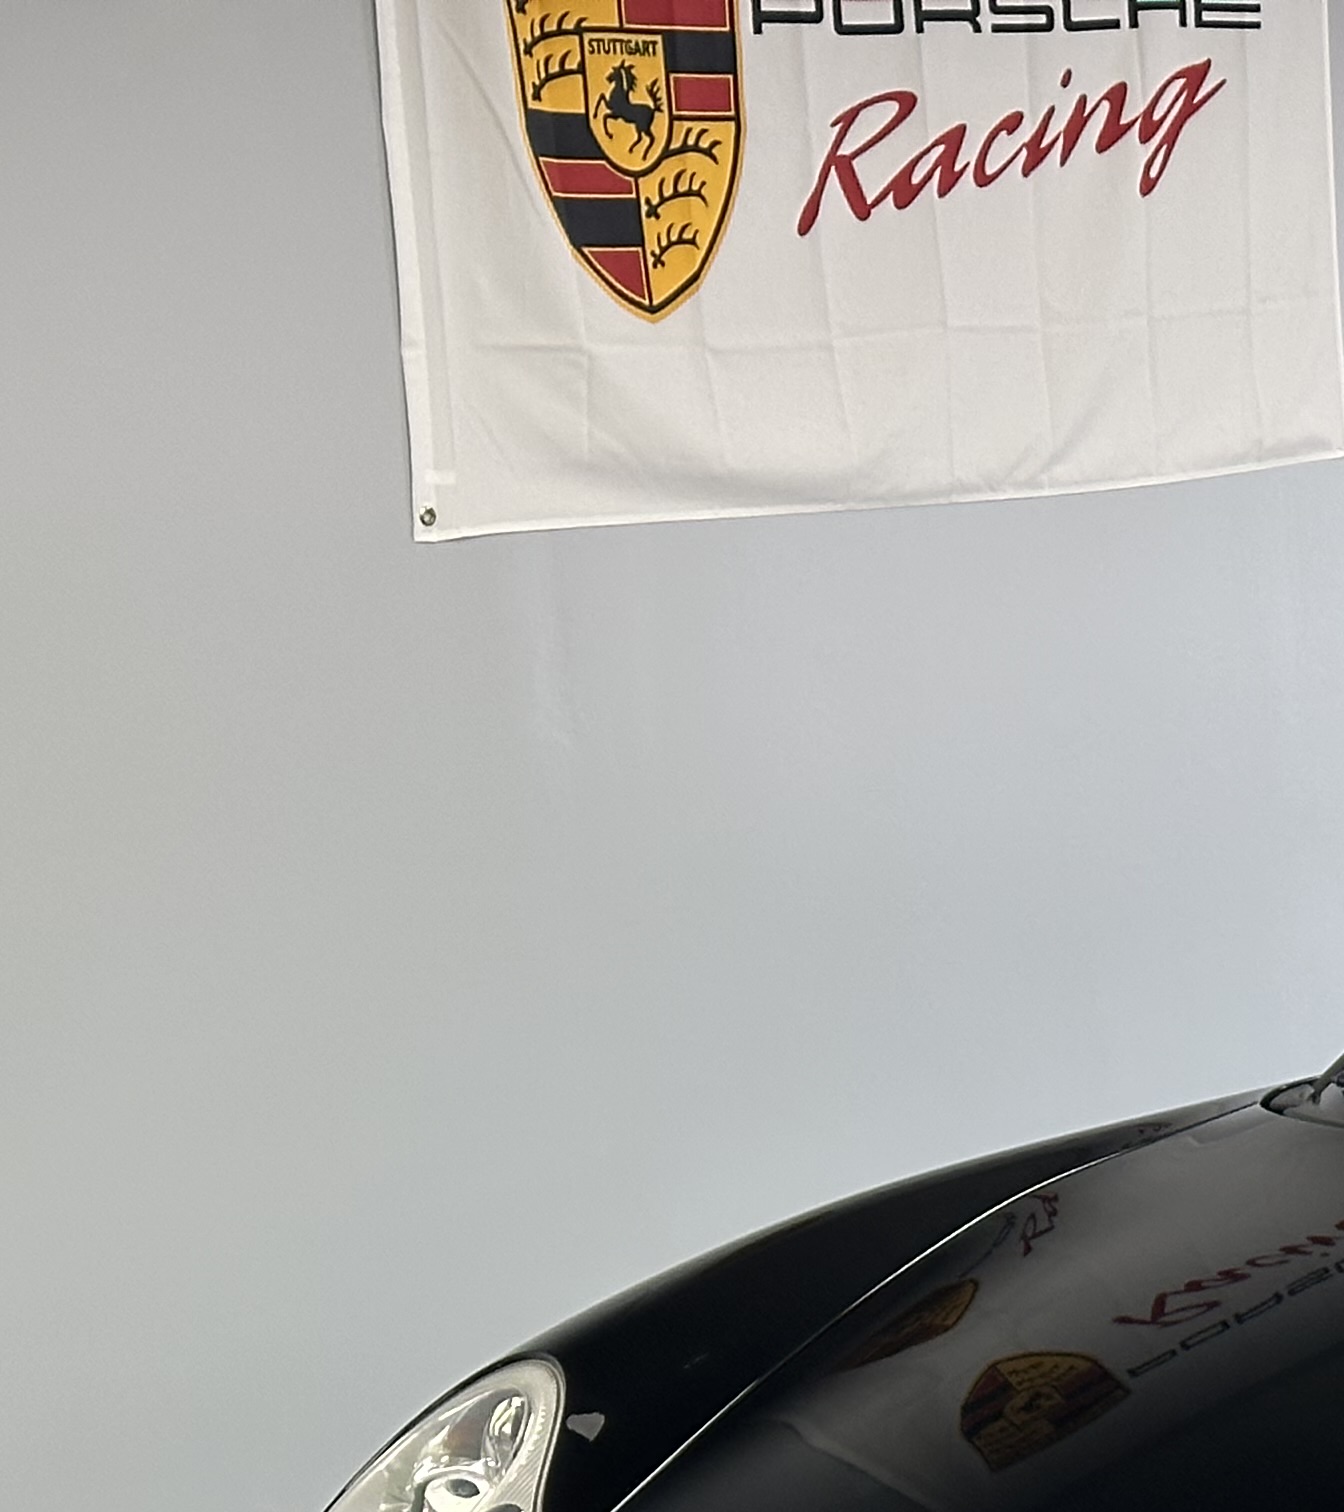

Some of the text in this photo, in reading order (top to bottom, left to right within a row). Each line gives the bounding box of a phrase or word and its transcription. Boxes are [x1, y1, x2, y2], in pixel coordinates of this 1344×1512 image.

[753, 0, 1262, 35] PORSCHE
[588, 38, 658, 56] STUTTGART
[797, 57, 1227, 237] Racing
